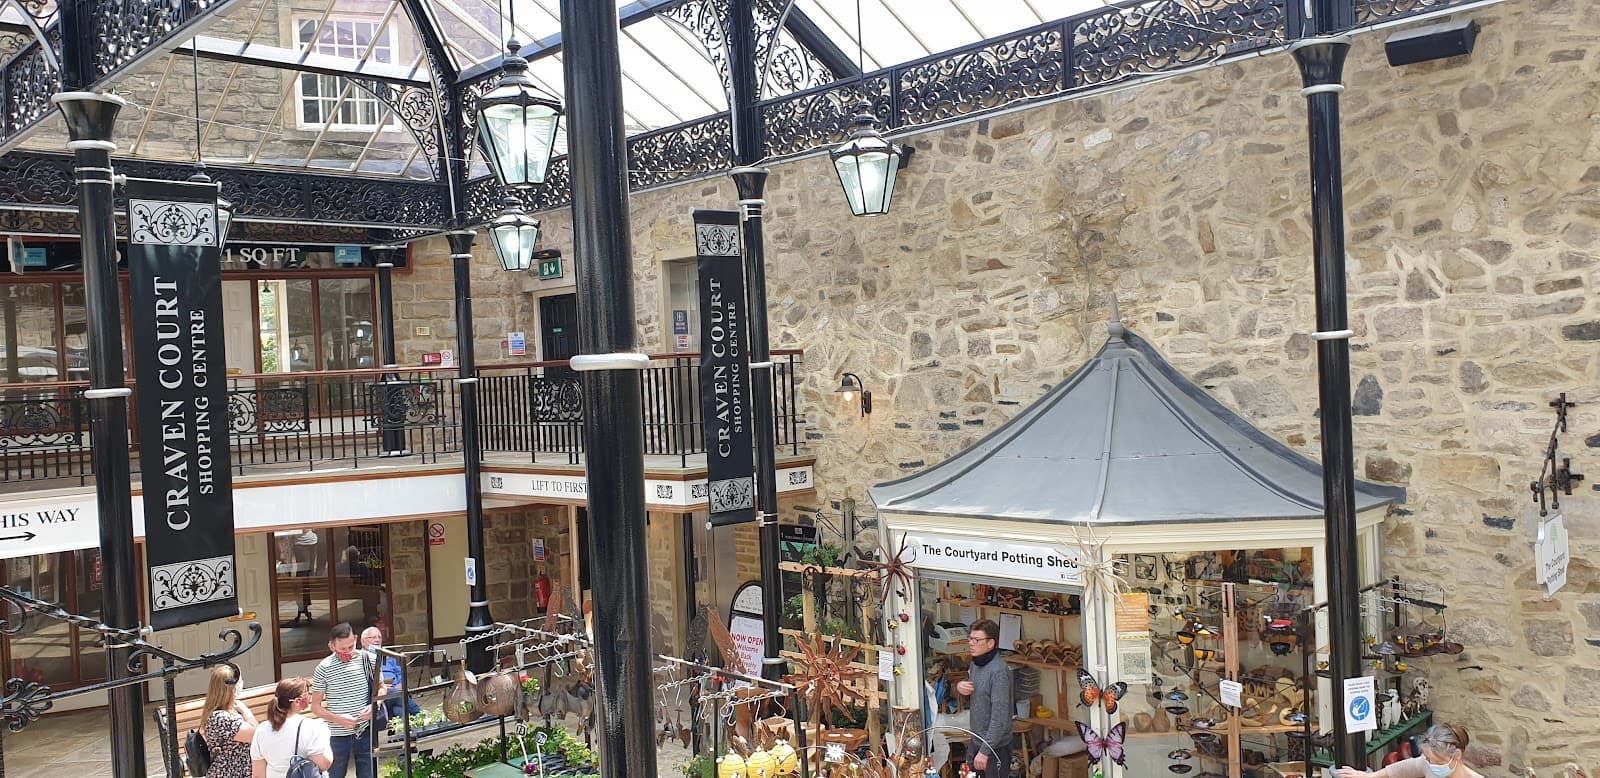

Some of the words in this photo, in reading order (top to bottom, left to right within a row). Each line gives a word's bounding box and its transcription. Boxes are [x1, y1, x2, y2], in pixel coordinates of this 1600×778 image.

[239, 247, 267, 266] SQ
[272, 247, 300, 262] FT
[153, 276, 183, 389] COURT
[190, 309, 208, 388] CENTRE
[709, 278, 726, 358] COURT
[727, 302, 738, 357] CENTRE
[714, 365, 731, 458] CRAVEN
[731, 363, 742, 433] SHOPPING
[161, 400, 191, 531] CRAVEN
[194, 396, 213, 494] SHOPPING
[36, 508, 79, 524] WAY
[532, 480, 549, 491] LIFT
[551, 480, 562, 492] TO
[922, 544, 941, 556] The
[945, 546, 999, 562] Courtyard
[1001, 551, 1043, 568] Potting
[1047, 555, 1078, 569] Shed
[731, 633, 746, 642] NOW
[748, 635, 763, 646] OPEN
[737, 643, 759, 654] Welcome
